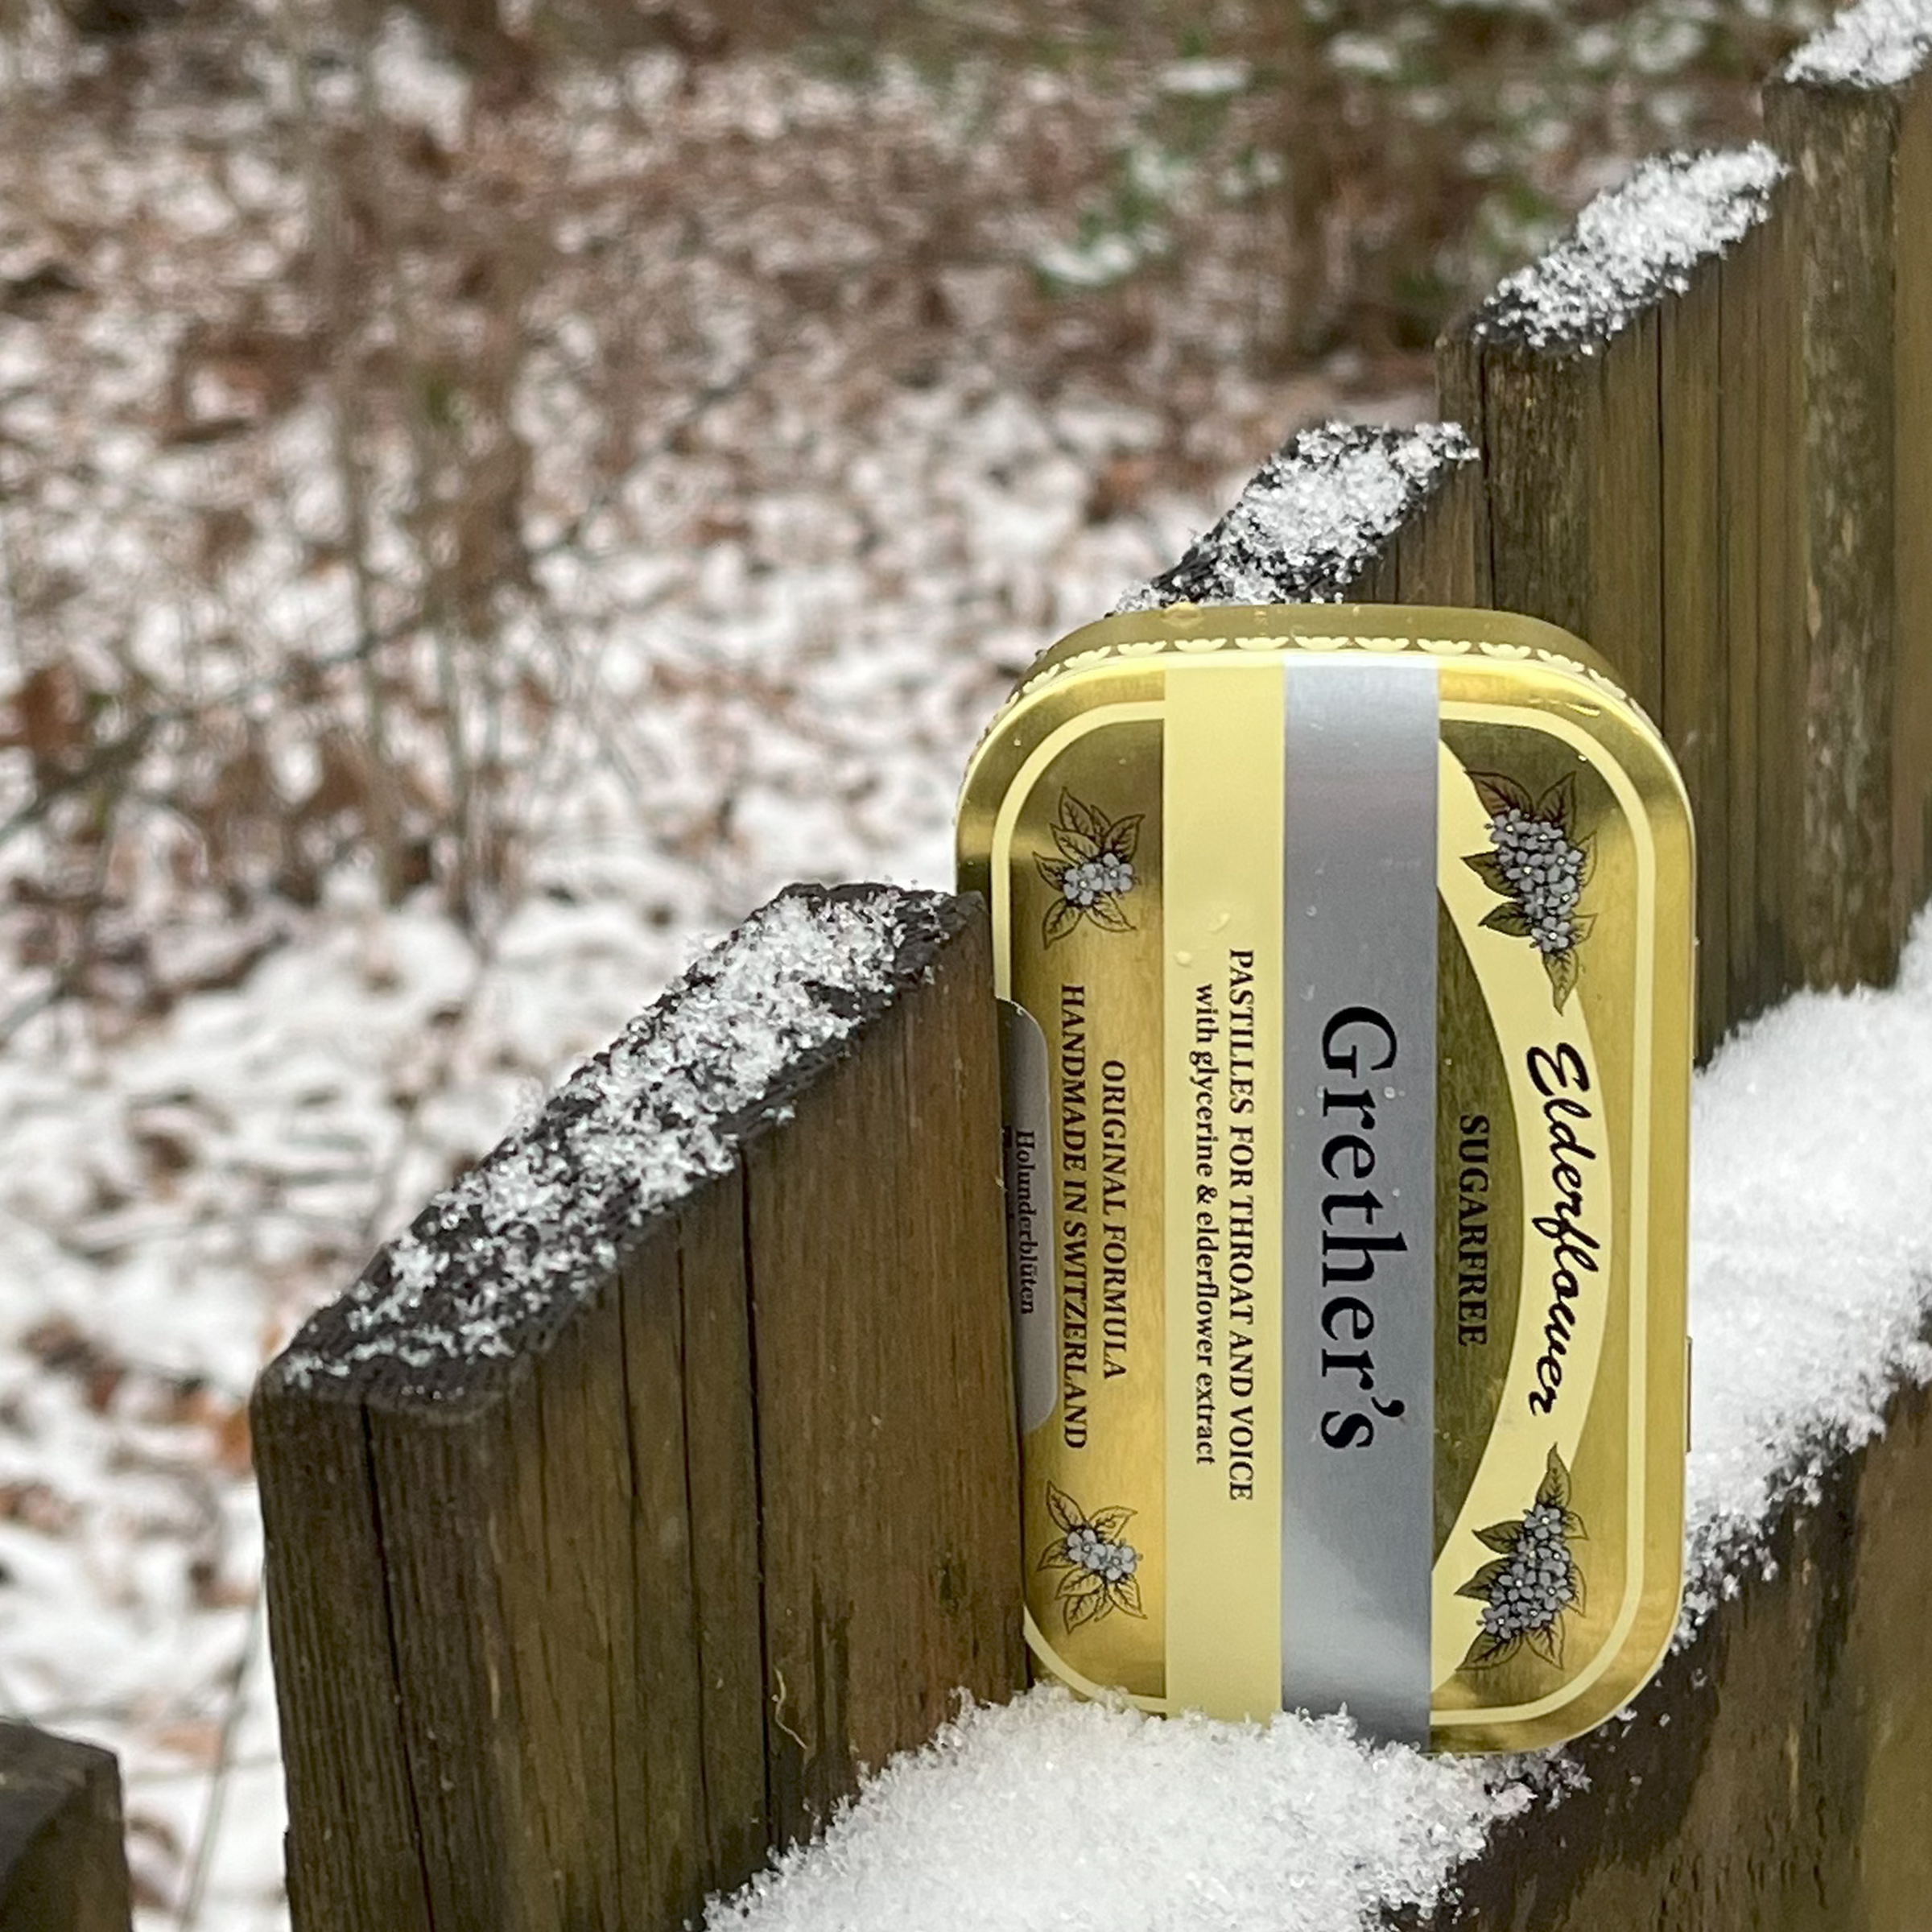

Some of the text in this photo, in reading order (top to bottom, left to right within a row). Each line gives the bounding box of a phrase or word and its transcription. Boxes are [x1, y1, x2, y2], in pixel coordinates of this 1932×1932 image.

[1015, 1129, 1038, 1315] Holunderblüten
[1061, 984, 1088, 1449] HANDMADE IN SWITZERLAND
[1101, 1059, 1128, 1381] ORIGINAL FORMULA
[1189, 983, 1220, 1465] with glycerine & elderflower extract
[1229, 948, 1254, 1501] PASTILLES FOR THROAT AND VOICE
[1457, 1114, 1490, 1348] SUGARFREE
[1526, 1042, 1600, 1415] Elderflower
